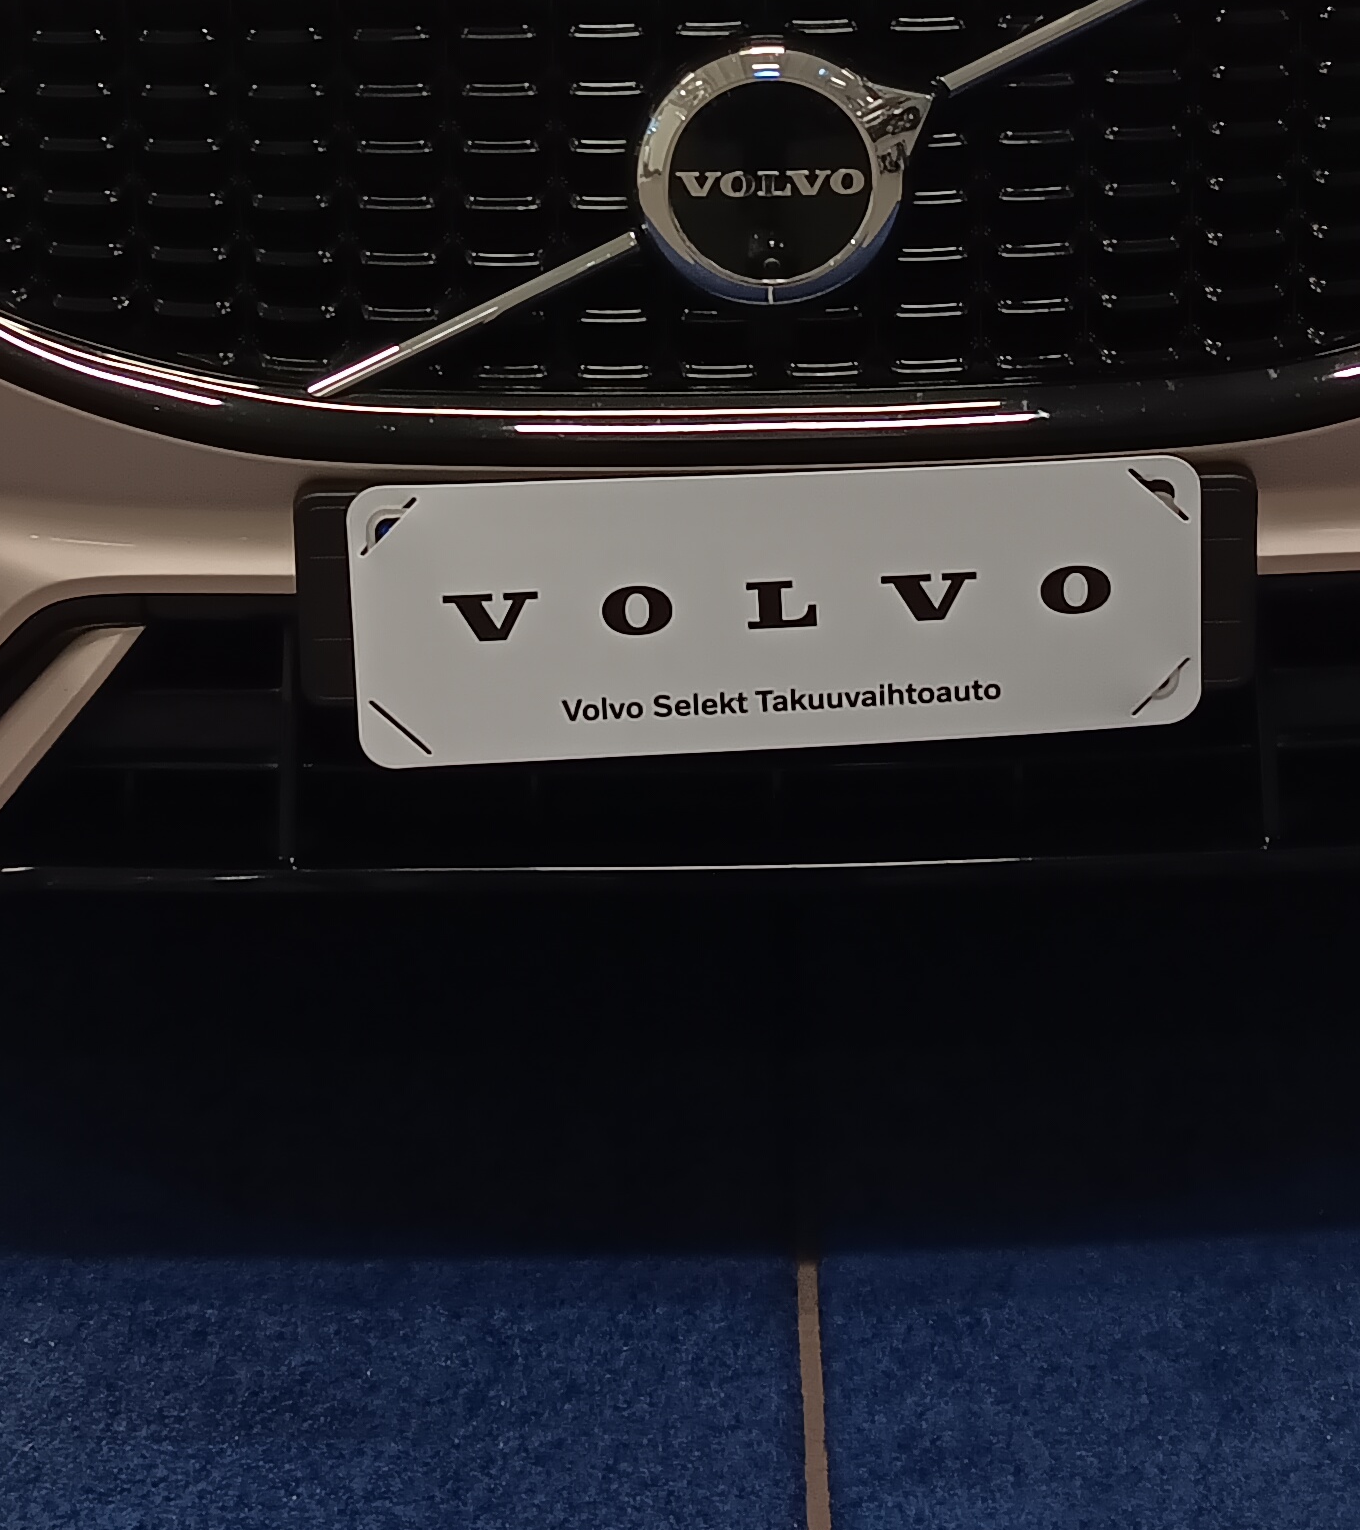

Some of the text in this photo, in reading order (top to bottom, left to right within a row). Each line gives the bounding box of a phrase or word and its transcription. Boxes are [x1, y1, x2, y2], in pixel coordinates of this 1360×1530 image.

[674, 168, 866, 198] VOLVO
[442, 565, 1113, 642] VOLVO
[561, 679, 1002, 722] Volvo Selekt Takuuvaihtoauto
